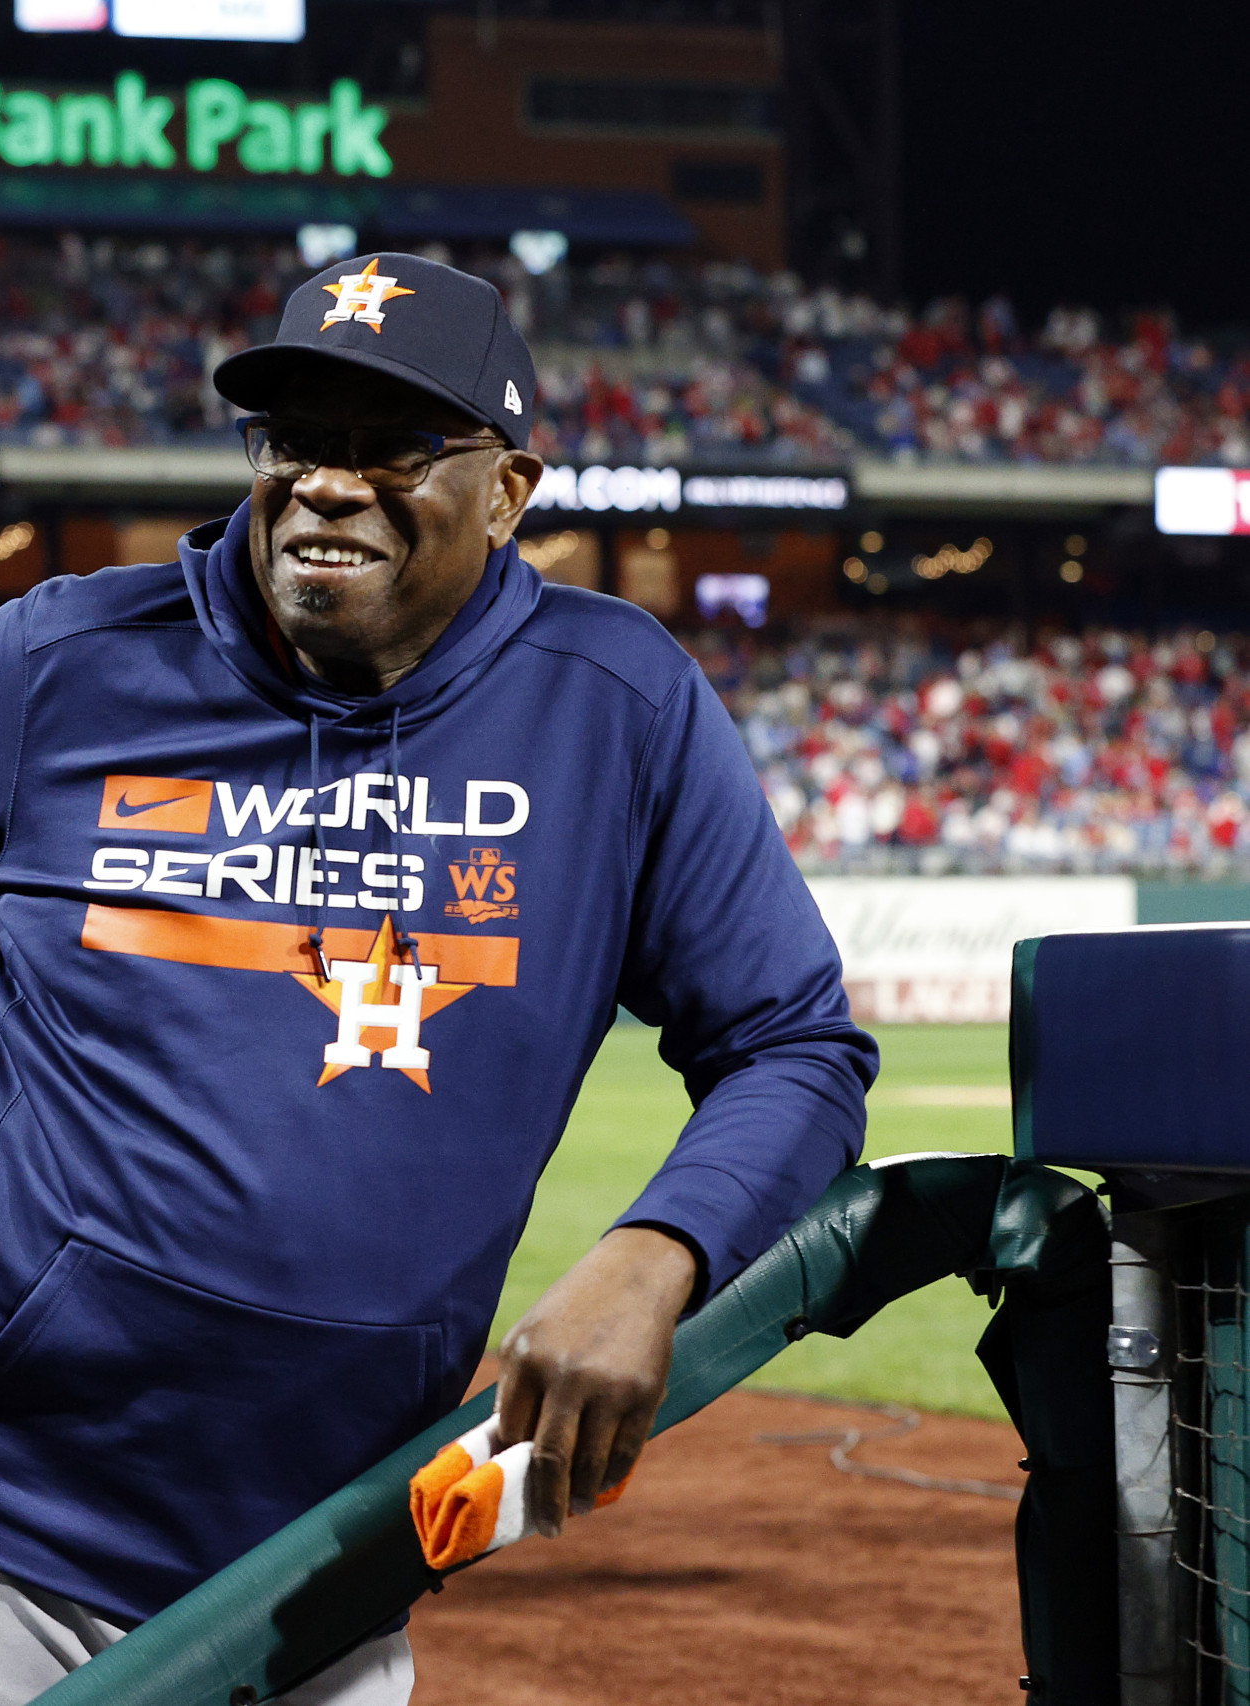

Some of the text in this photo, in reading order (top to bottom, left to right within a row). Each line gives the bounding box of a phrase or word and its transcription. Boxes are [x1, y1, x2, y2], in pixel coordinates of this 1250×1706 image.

[186, 78, 393, 178] Park
[324, 274, 398, 324] H
[216, 773, 530, 837] WORLD
[82, 844, 424, 911] SERIES
[448, 864, 517, 902] WS
[324, 959, 437, 1069] H
